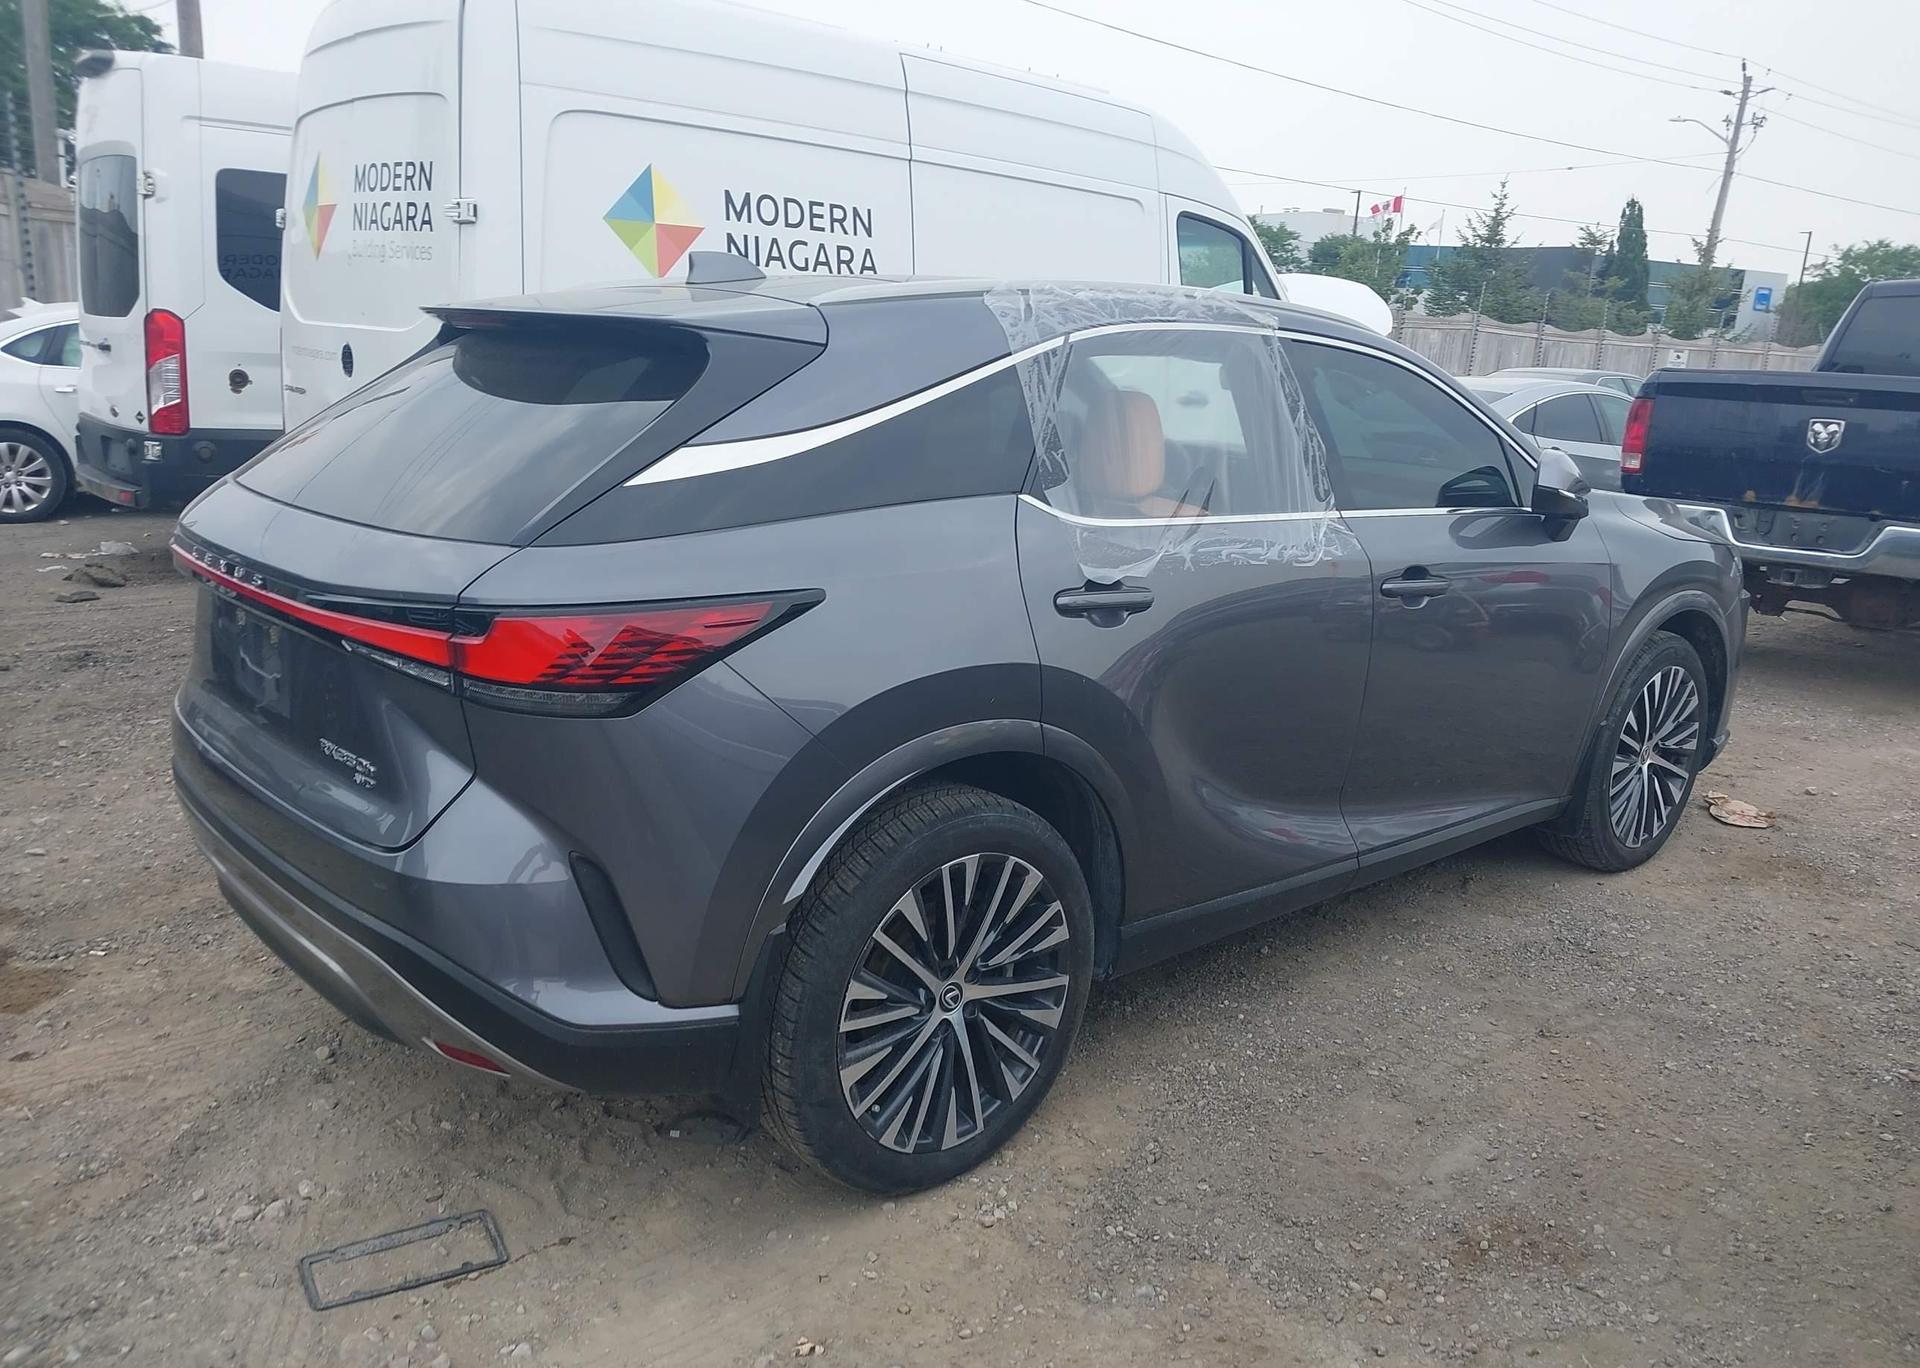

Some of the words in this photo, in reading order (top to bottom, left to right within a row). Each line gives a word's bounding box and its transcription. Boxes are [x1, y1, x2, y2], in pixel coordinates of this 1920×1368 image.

[354, 161, 434, 193] MODERN
[352, 201, 434, 232] NIAGARA
[724, 189, 873, 238] MODERN
[388, 239, 433, 261] Services
[725, 232, 878, 275] NIAGARA
[192, 545, 264, 586] LEXUS
